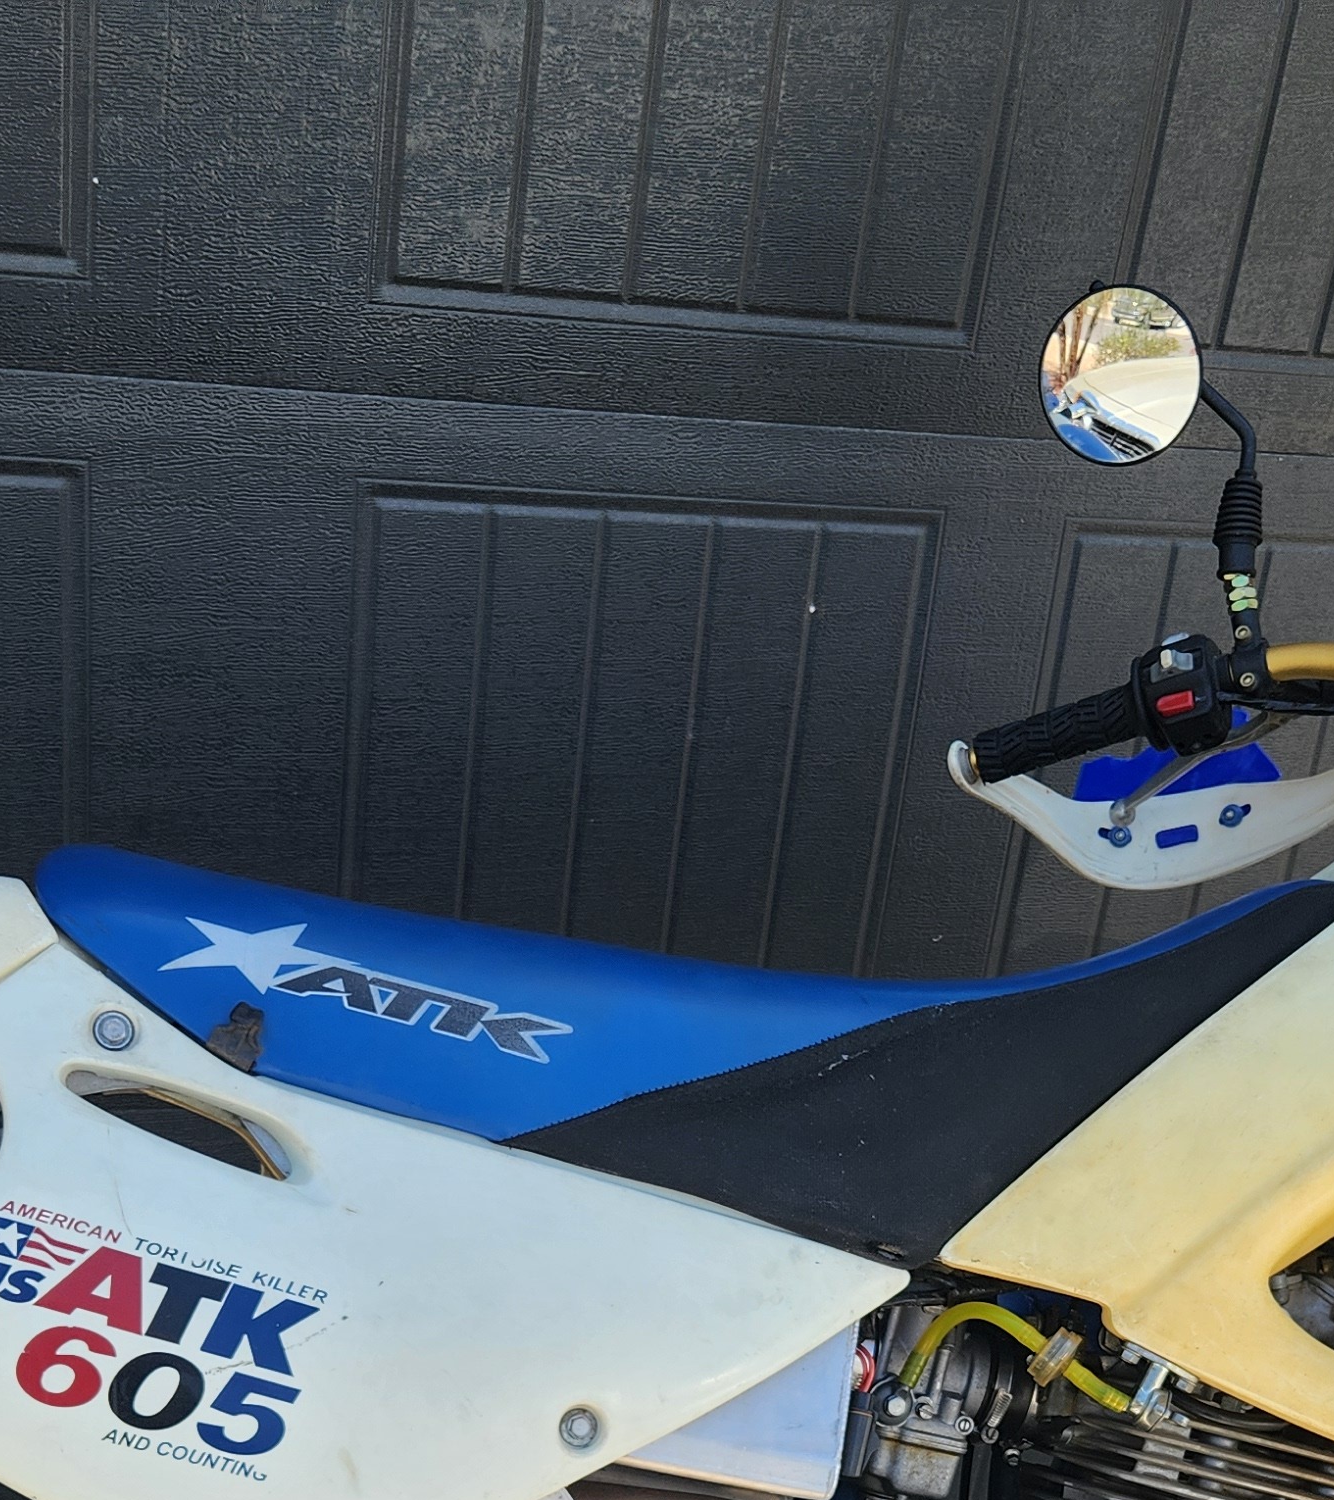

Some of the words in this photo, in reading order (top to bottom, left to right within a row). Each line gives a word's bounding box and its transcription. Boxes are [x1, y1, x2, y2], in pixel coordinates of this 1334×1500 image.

[269, 963, 574, 1064] ATK
[34, 1246, 320, 1376] ATK
[252, 1271, 328, 1304] KILLER
[16, 1325, 302, 1455] 605
[101, 1429, 151, 1451] AND
